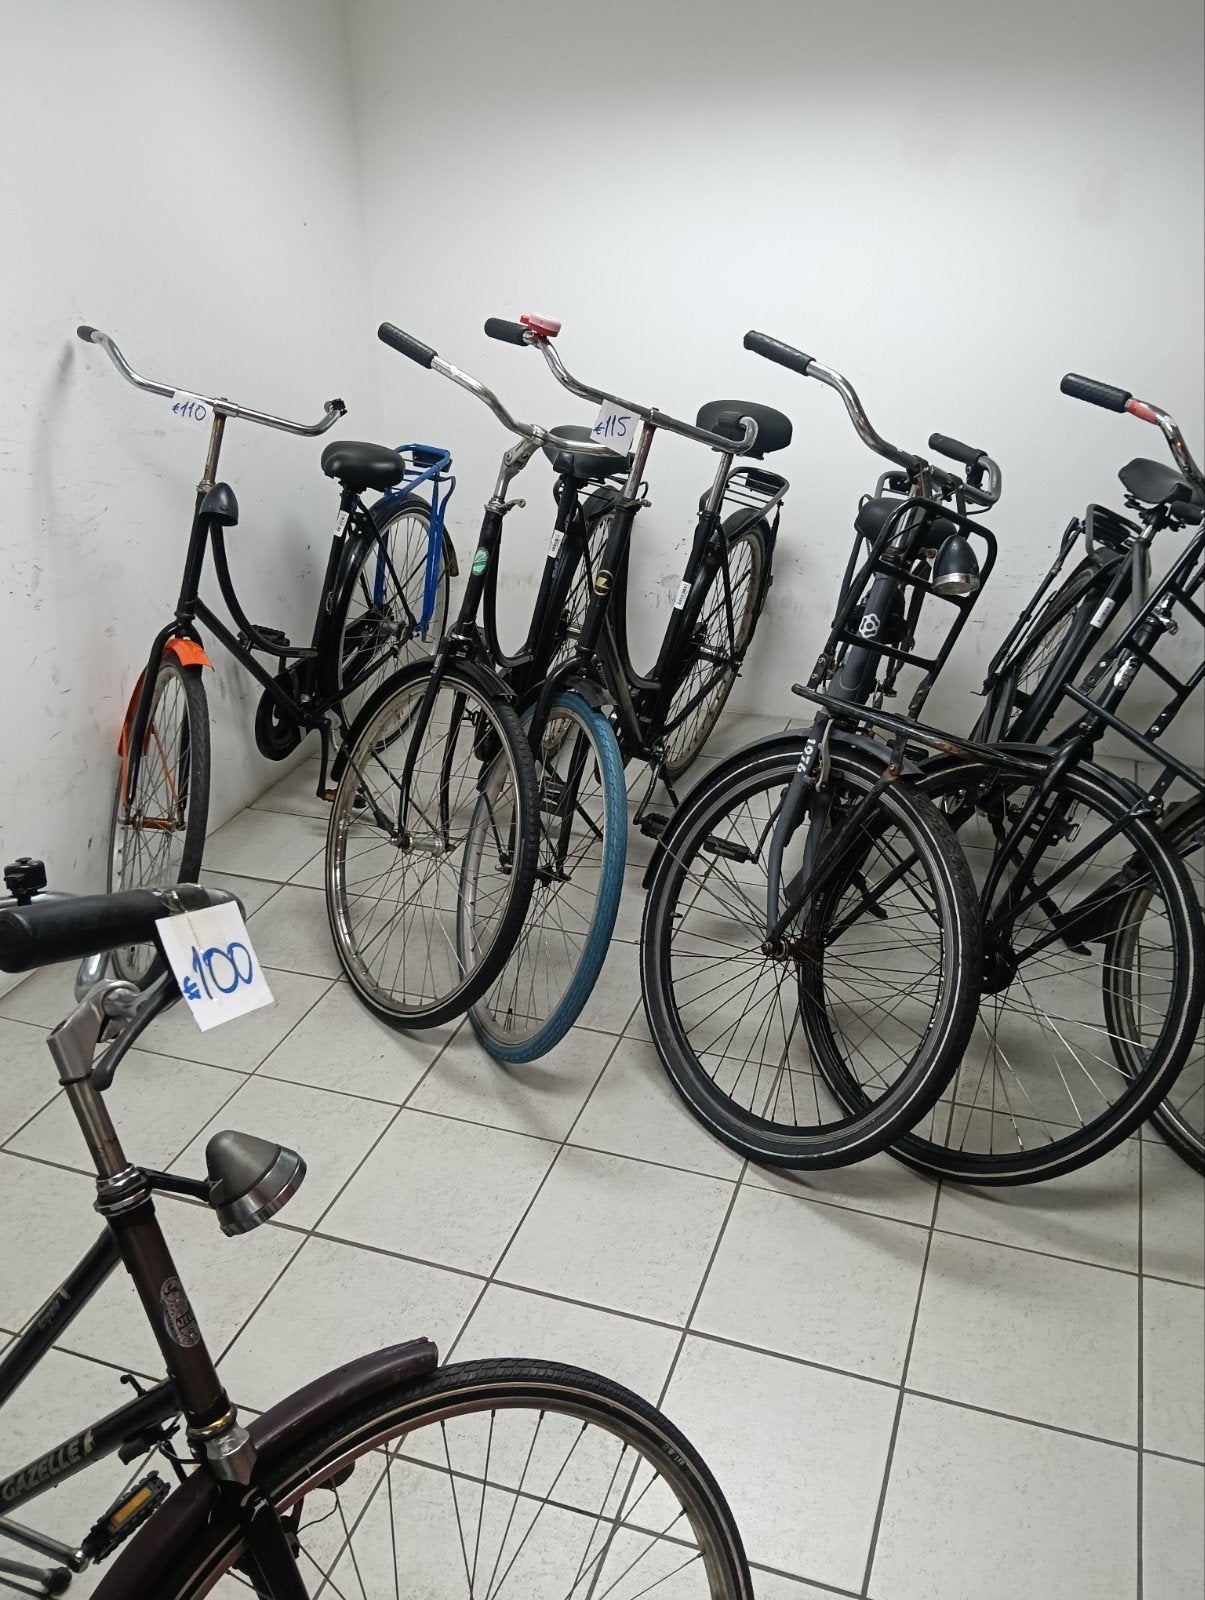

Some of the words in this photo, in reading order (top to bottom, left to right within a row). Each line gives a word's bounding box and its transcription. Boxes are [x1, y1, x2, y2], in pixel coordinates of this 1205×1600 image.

[172, 401, 207, 420] €110
[593, 415, 631, 437] €115
[797, 738, 816, 773] 1076
[182, 942, 253, 1000] €100
[1, 1439, 81, 1501] GAZELLE
